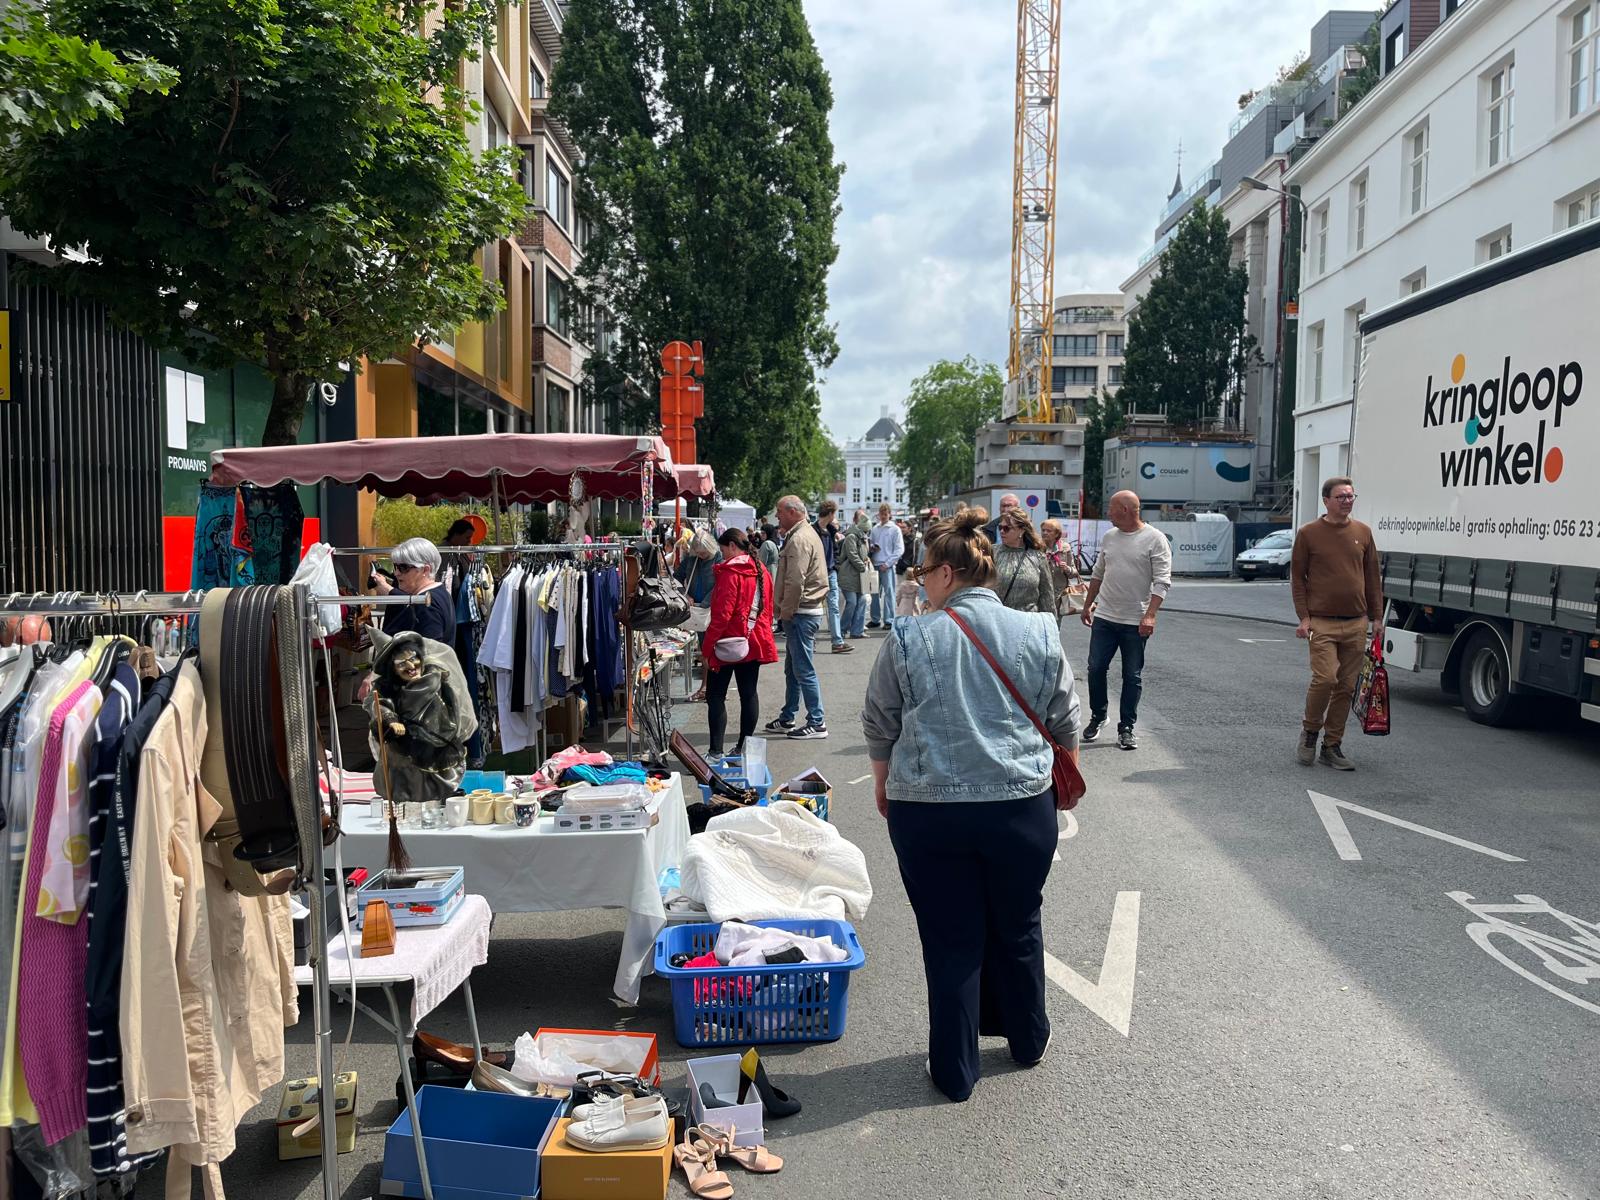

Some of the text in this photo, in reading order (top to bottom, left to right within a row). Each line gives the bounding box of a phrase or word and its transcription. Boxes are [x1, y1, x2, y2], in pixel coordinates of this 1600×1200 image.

[1423, 354, 1583, 437] kringloop
[1440, 417, 1546, 488] winkel
[168, 455, 207, 472] PROMANYS
[1378, 516, 1461, 535] dekringloopwinkel.be
[1467, 517, 1496, 537] gratis
[1498, 516, 1550, 540] ophaling:
[1553, 519, 1576, 537] 056
[1579, 519, 1594, 537] 23
[1179, 541, 1218, 551] coussée
[116, 804, 124, 819] EAST
